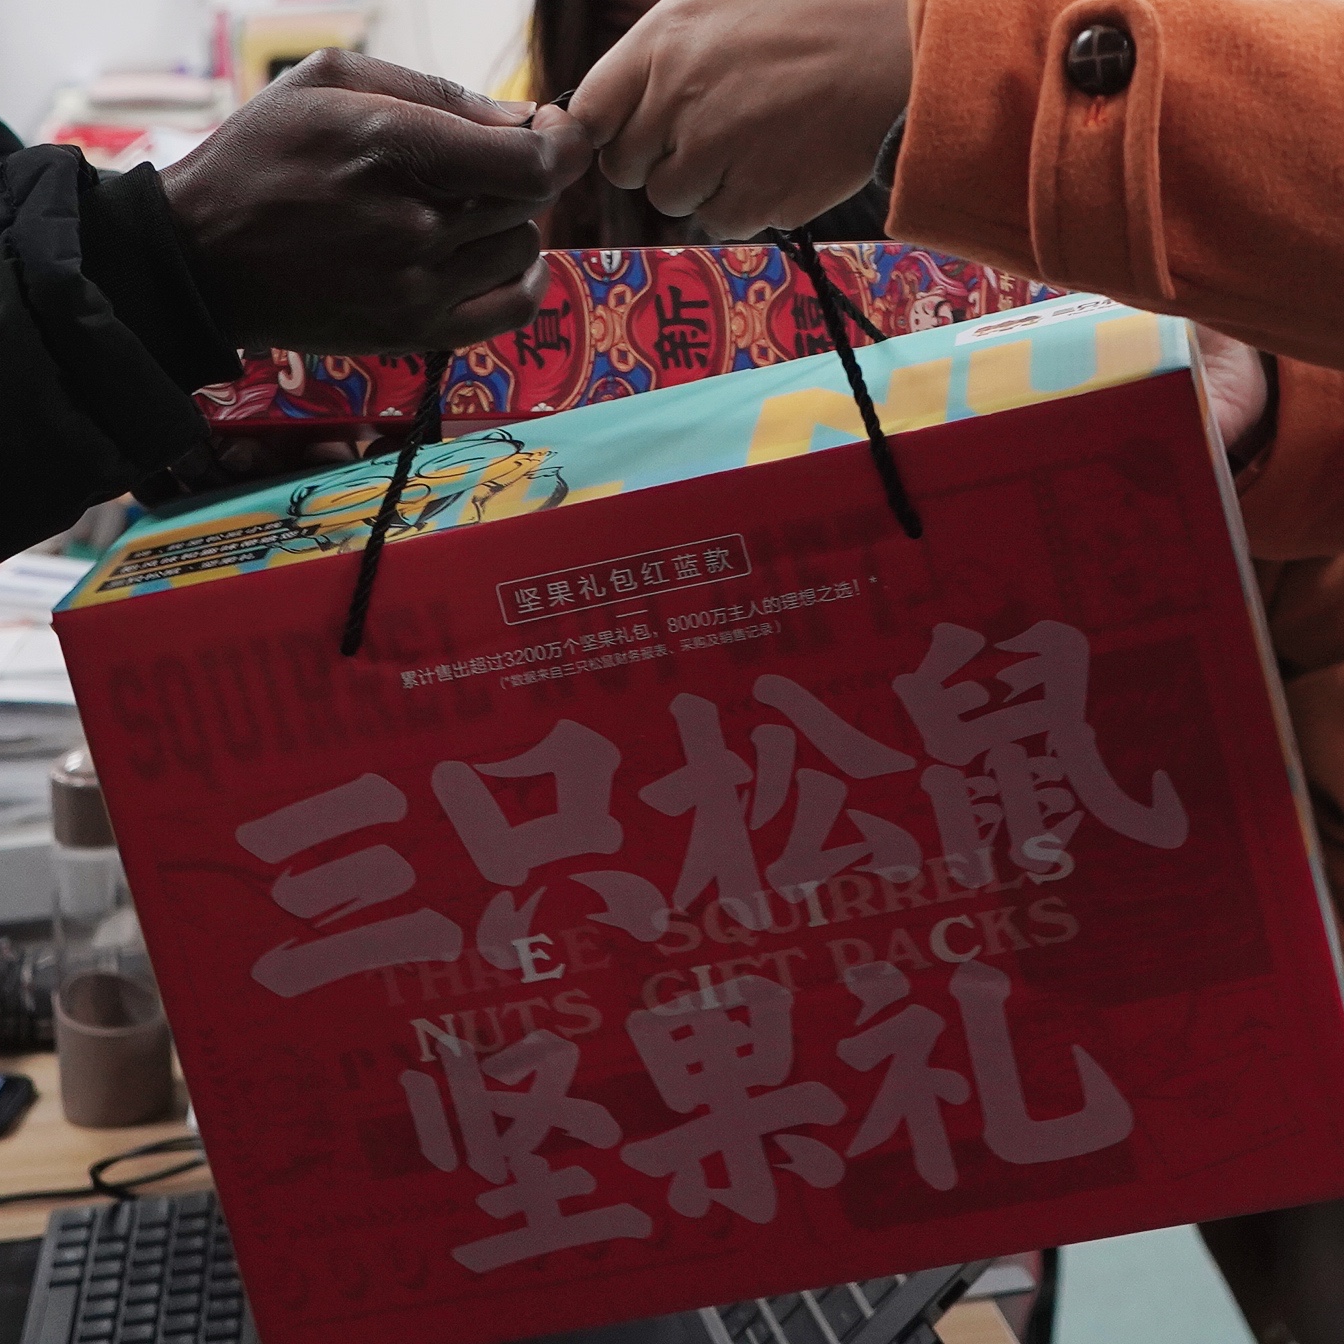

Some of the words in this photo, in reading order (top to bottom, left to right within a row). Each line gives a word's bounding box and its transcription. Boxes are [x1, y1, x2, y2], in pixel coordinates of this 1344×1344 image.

[514, 547, 736, 614] 坚果礼包红蓝款
[235, 618, 1189, 998] 三只松鼠
[651, 831, 1076, 956] SQUIRRELS
[409, 989, 605, 1064] NUTS
[641, 947, 809, 1017] GIFT
[822, 894, 1082, 992] PACKS
[398, 958, 1135, 1276] 坚果礼
